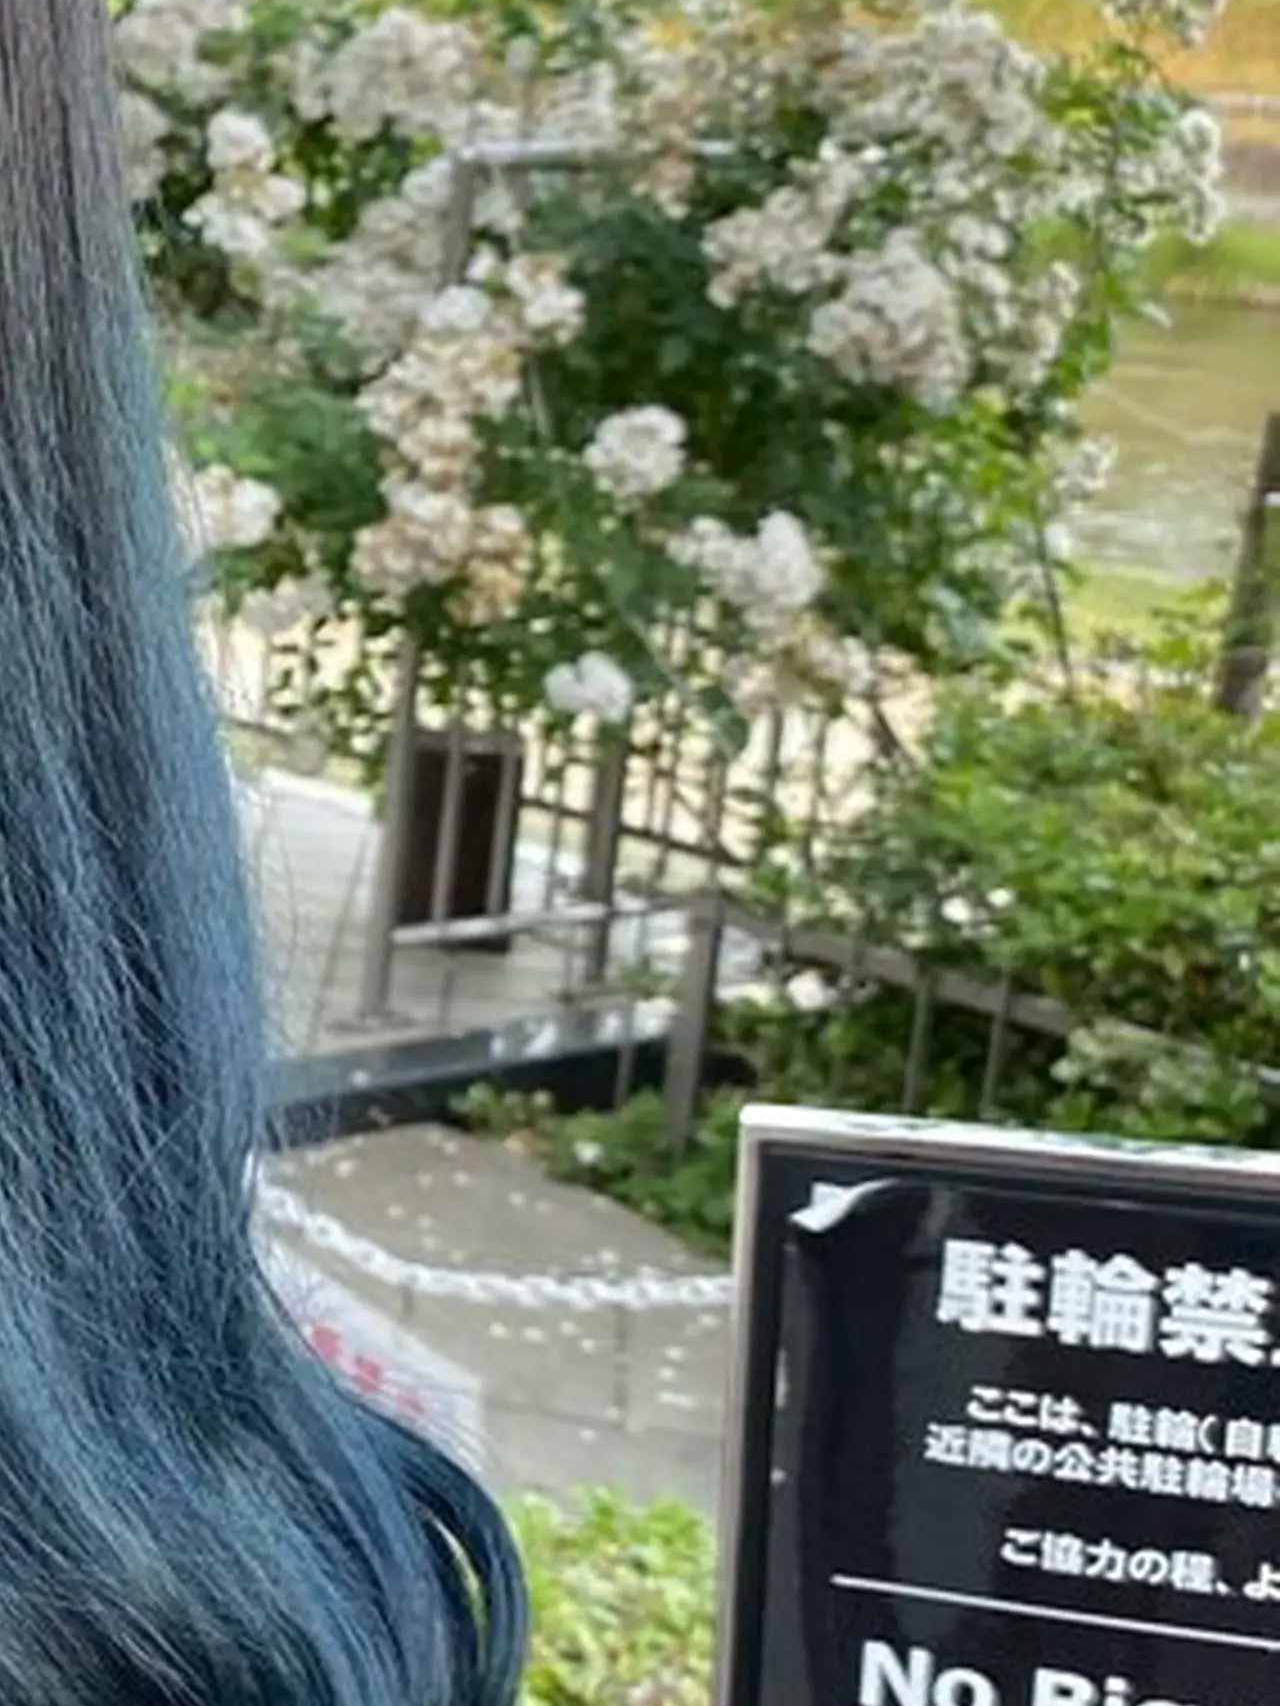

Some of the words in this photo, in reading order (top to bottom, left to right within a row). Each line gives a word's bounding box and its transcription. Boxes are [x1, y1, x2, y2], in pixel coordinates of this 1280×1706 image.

[937, 1238, 1280, 1367] 駐輪禁
[924, 1422, 1280, 1507] 近隣の公共駐輪場
